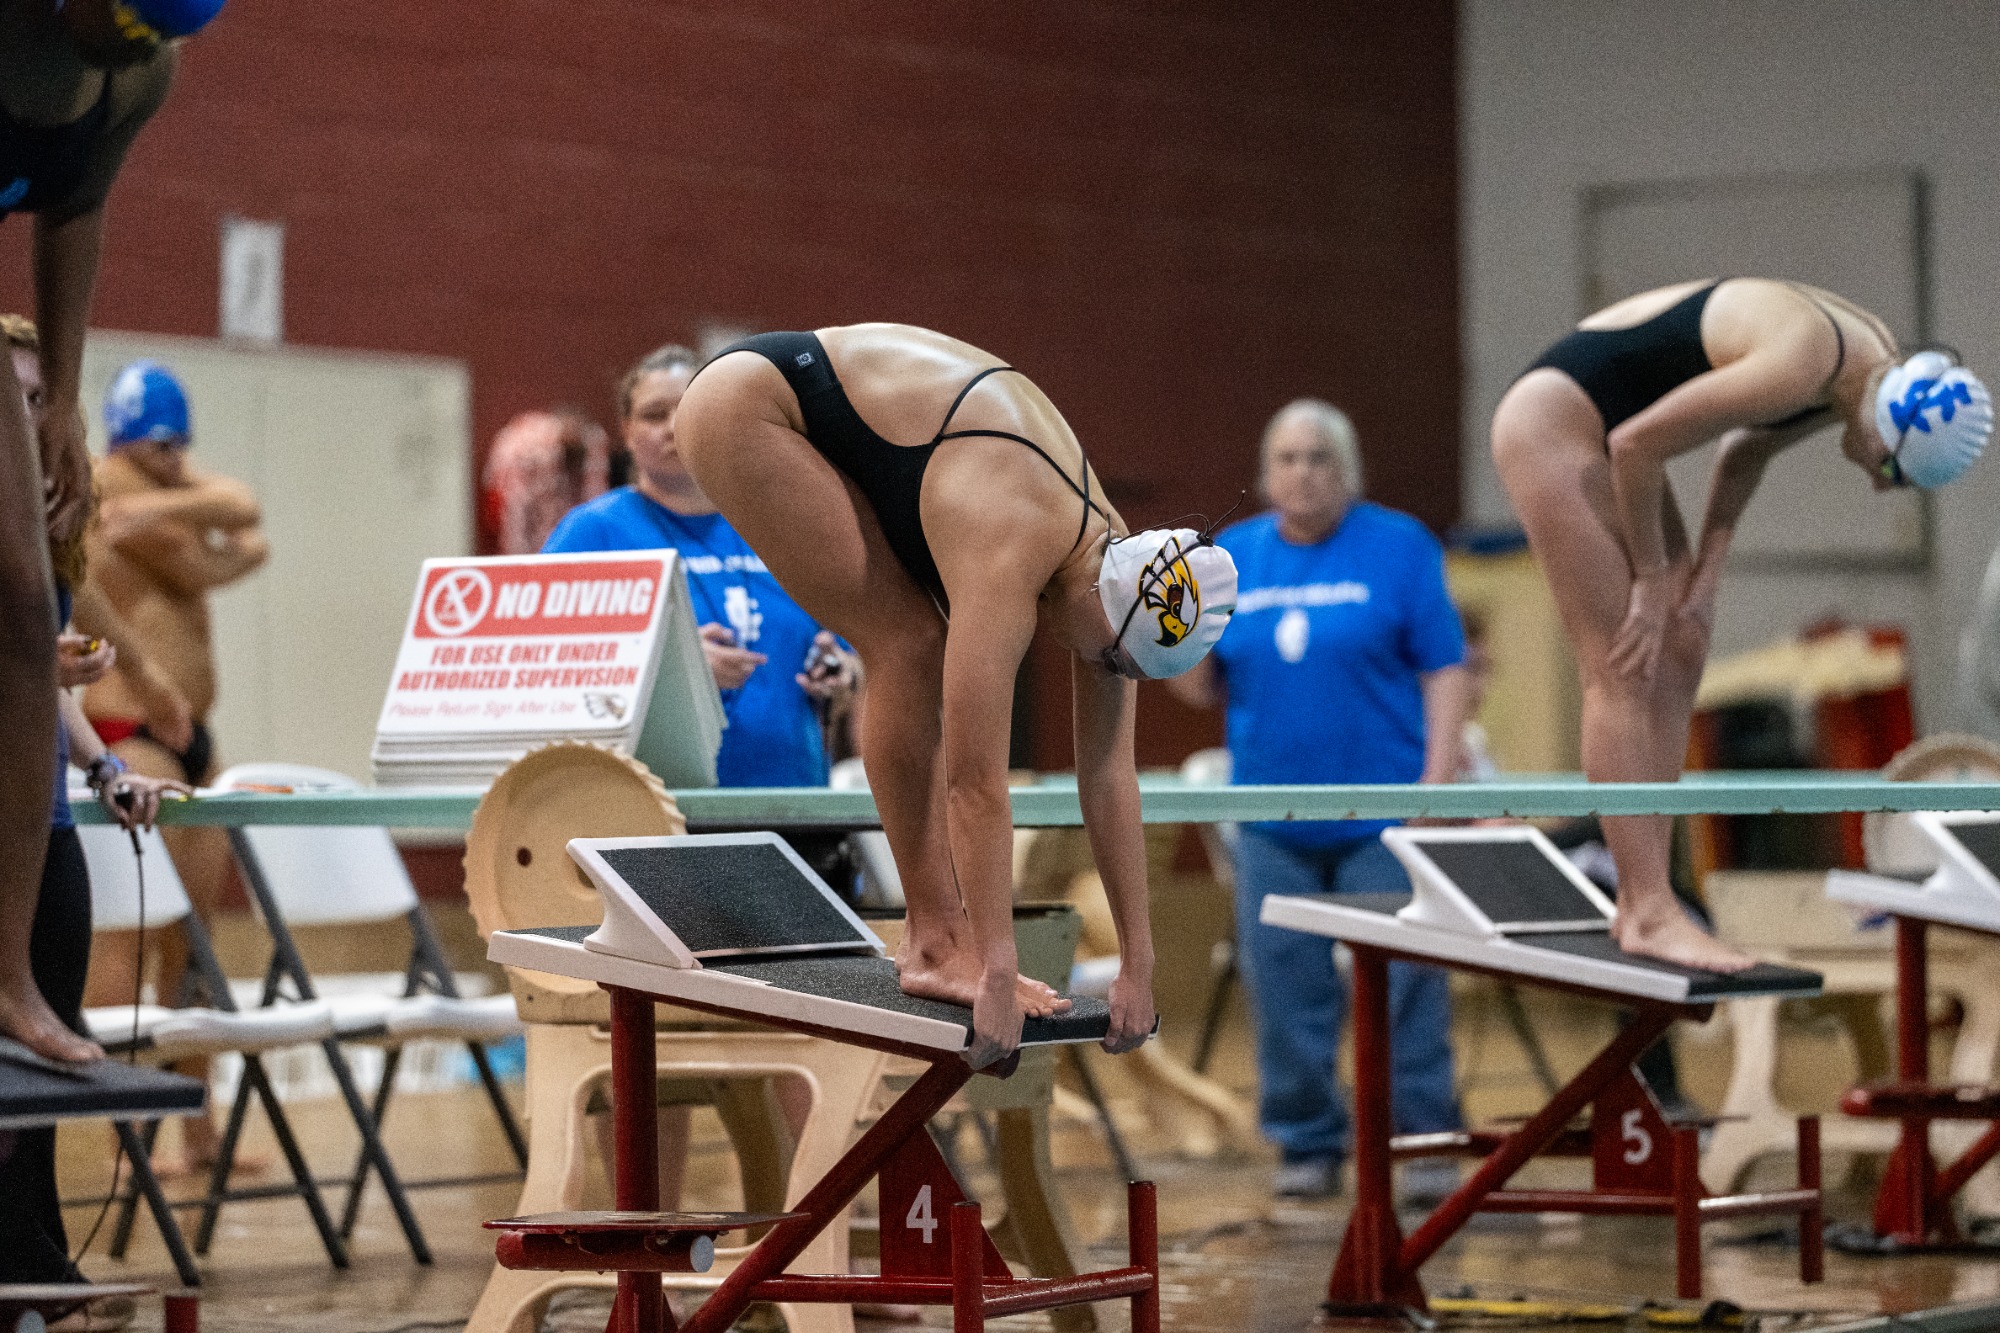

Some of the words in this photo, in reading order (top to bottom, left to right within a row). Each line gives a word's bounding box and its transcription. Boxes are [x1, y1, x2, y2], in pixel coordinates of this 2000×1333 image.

[496, 582, 542, 619] NO
[545, 578, 655, 617] DIVING
[431, 646, 466, 665] FOR
[470, 645, 504, 664] USE
[508, 643, 554, 664] ONLY
[557, 642, 619, 663] UNDER
[397, 669, 511, 691] AUTHORIZED
[515, 666, 639, 689] SUPERVISION
[1622, 1109, 1652, 1165] 5
[906, 1184, 938, 1244] 4
